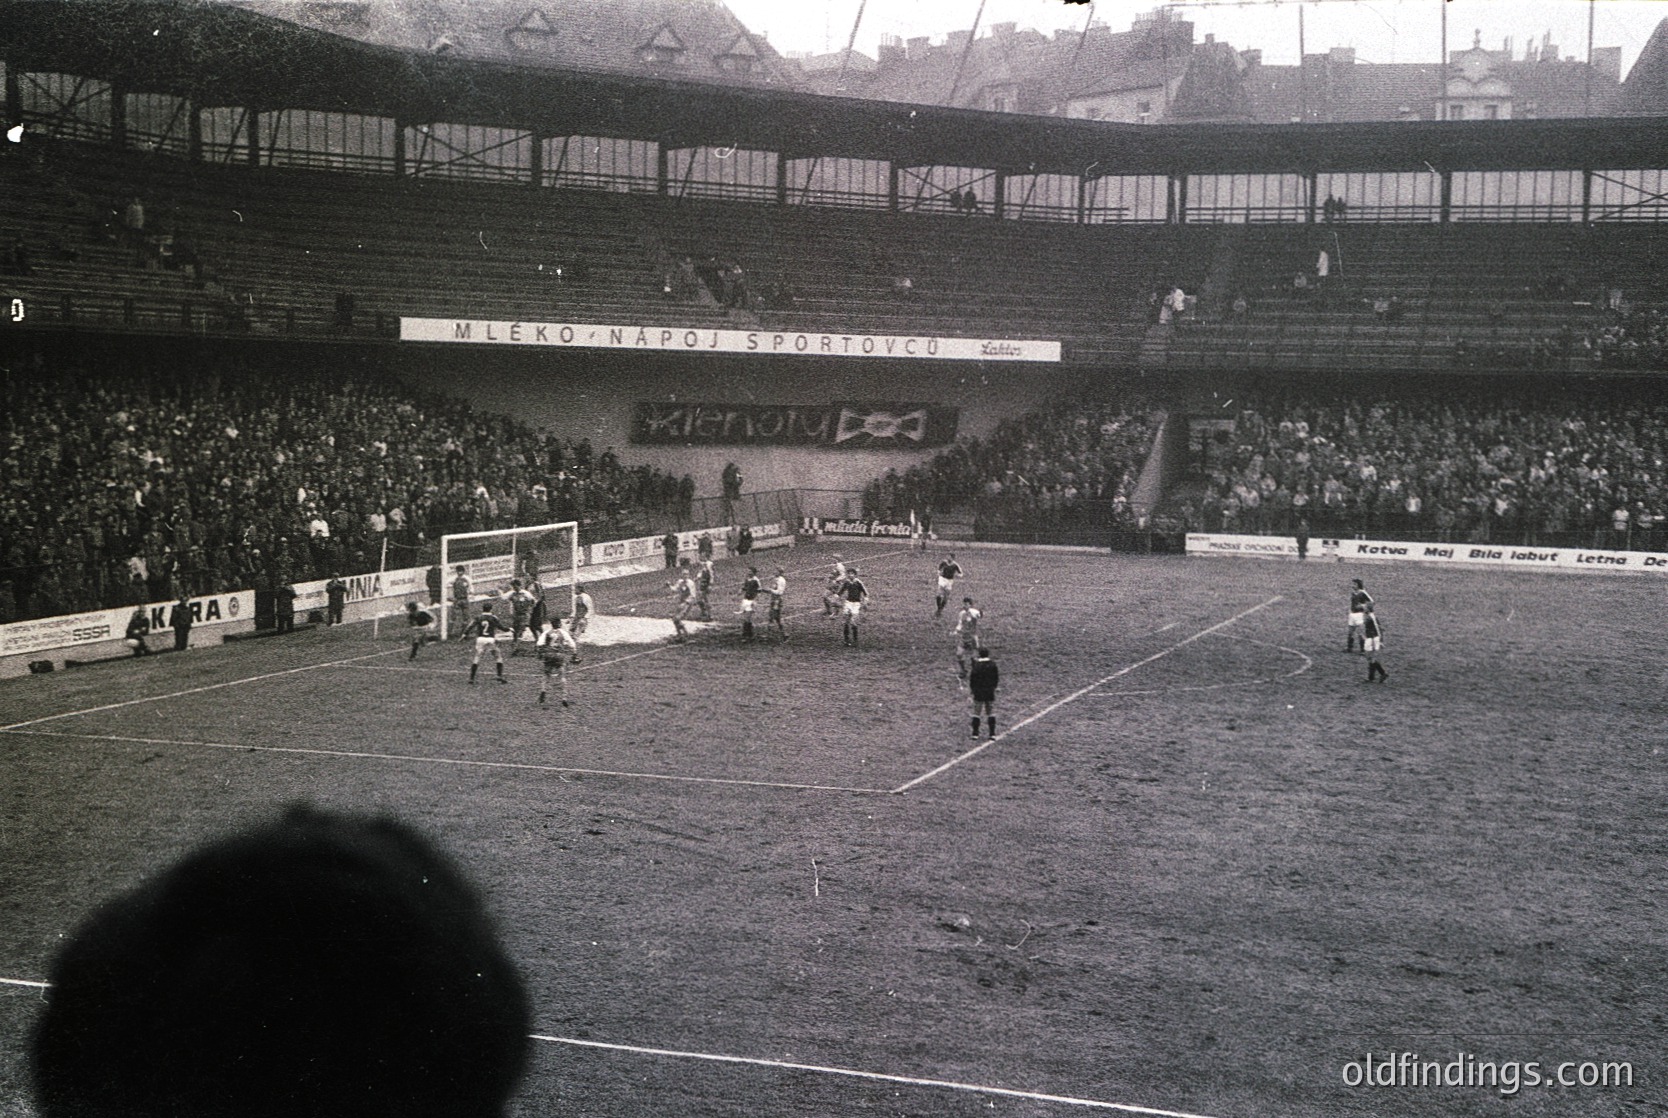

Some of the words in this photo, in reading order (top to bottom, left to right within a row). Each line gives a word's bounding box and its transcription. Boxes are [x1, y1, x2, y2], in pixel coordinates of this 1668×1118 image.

[455, 322, 574, 344] MLÉKO
[610, 326, 719, 349] NÁPOJ
[1357, 544, 1409, 555] Kotva
[481, 620, 490, 636] 2
